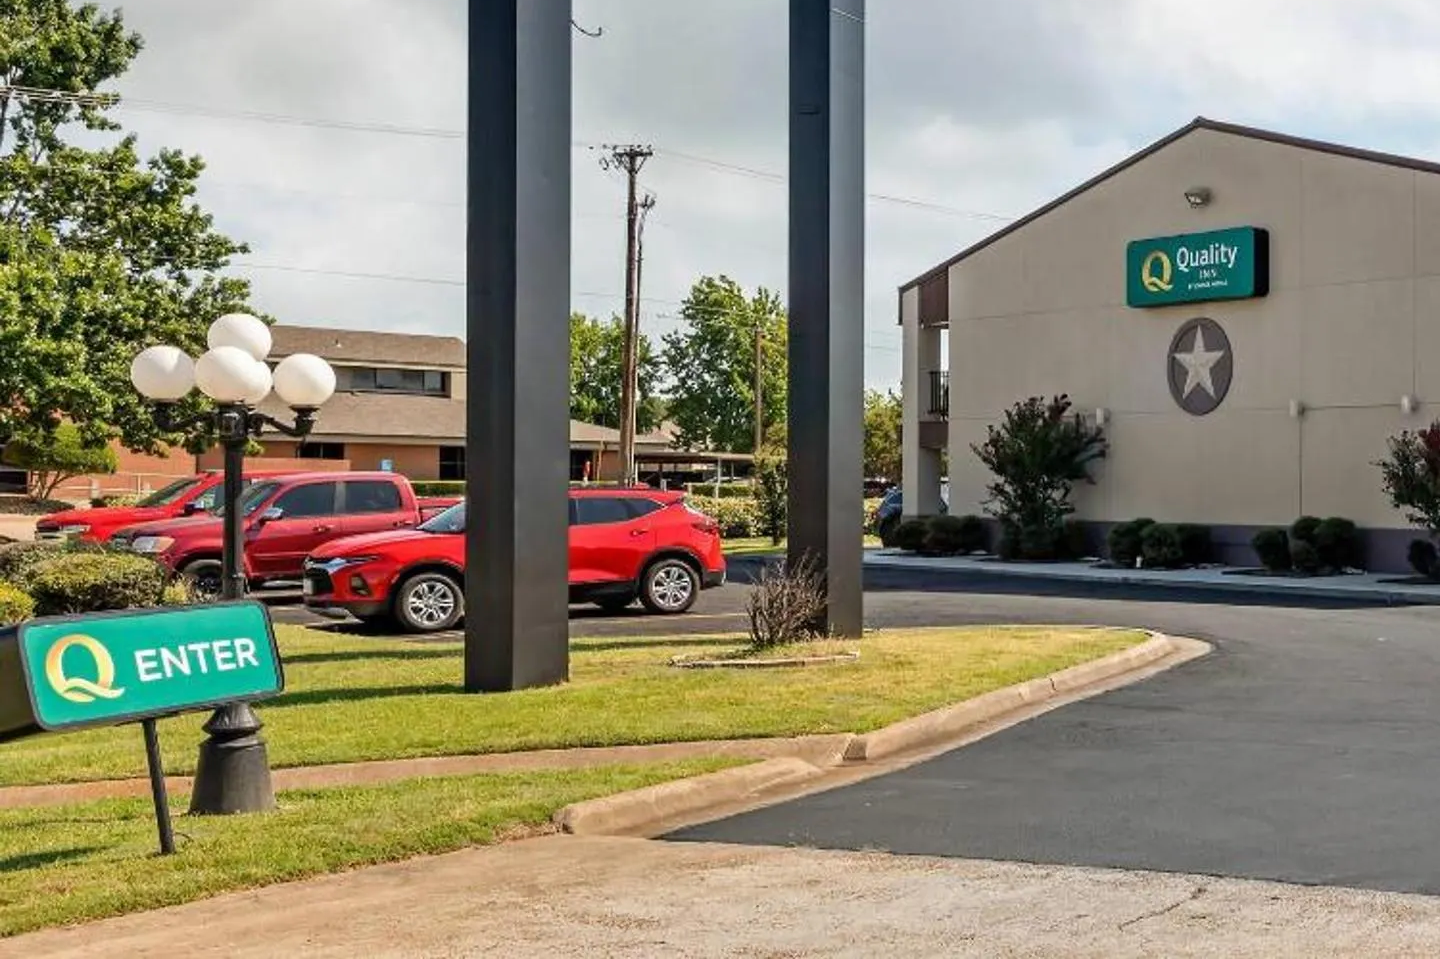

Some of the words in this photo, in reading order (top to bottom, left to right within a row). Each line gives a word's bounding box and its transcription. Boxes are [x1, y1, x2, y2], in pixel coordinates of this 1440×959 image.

[1142, 250, 1173, 292] Q
[1176, 243, 1238, 272] Quality
[45, 634, 125, 703] Q
[133, 638, 260, 682] ENTER
